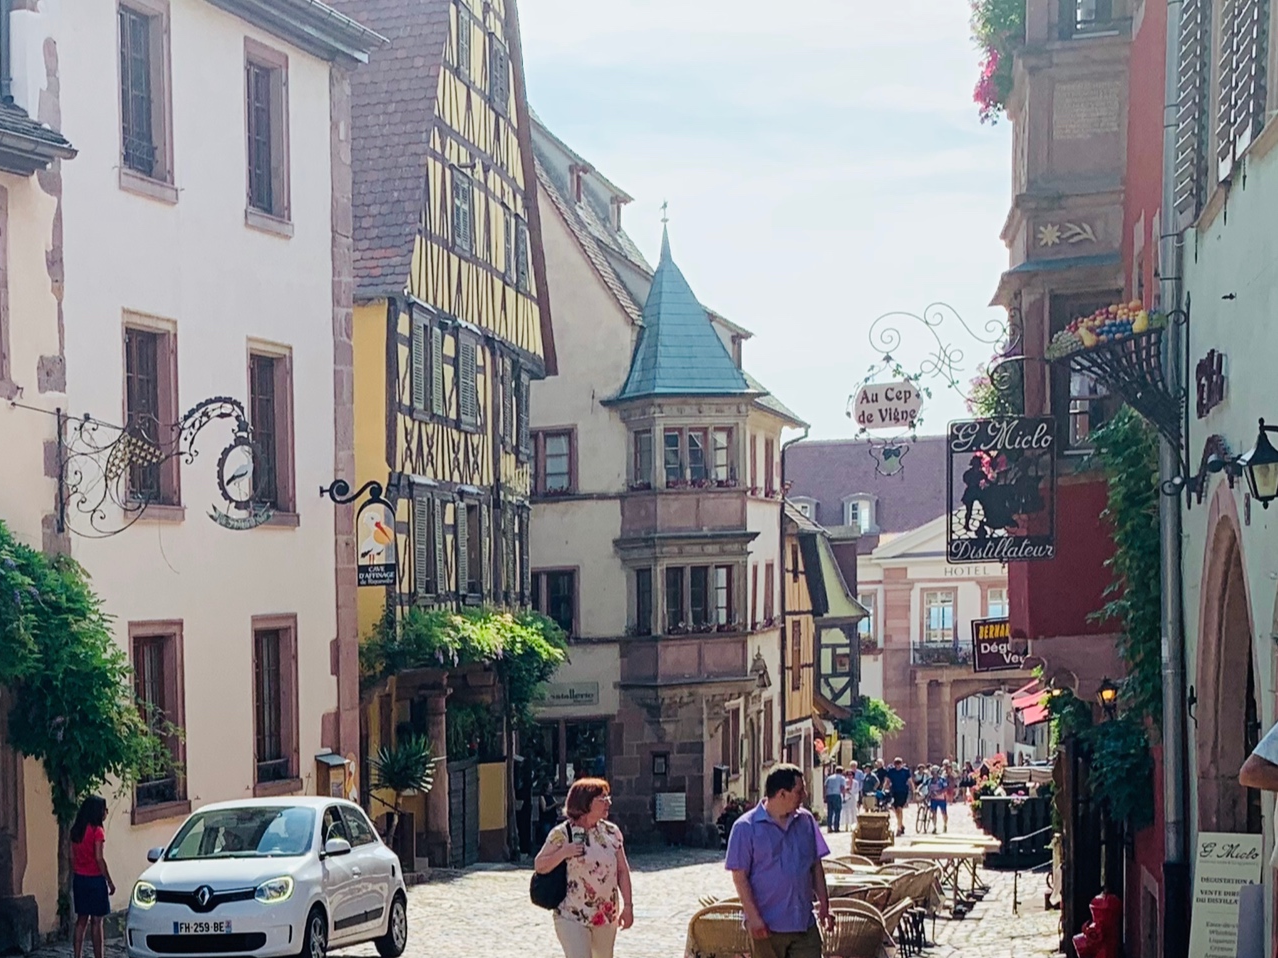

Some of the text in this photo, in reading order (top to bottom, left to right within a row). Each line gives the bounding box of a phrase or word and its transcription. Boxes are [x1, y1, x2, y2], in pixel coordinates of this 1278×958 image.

[860, 387, 911, 404] Au Cep
[858, 407, 917, 424] de Vigne
[980, 420, 1053, 450] Miclo
[951, 537, 1054, 559] Distillateur
[944, 566, 989, 577] HOTEL
[981, 641, 1010, 654] Dég
[1216, 843, 1260, 860] Miclo
